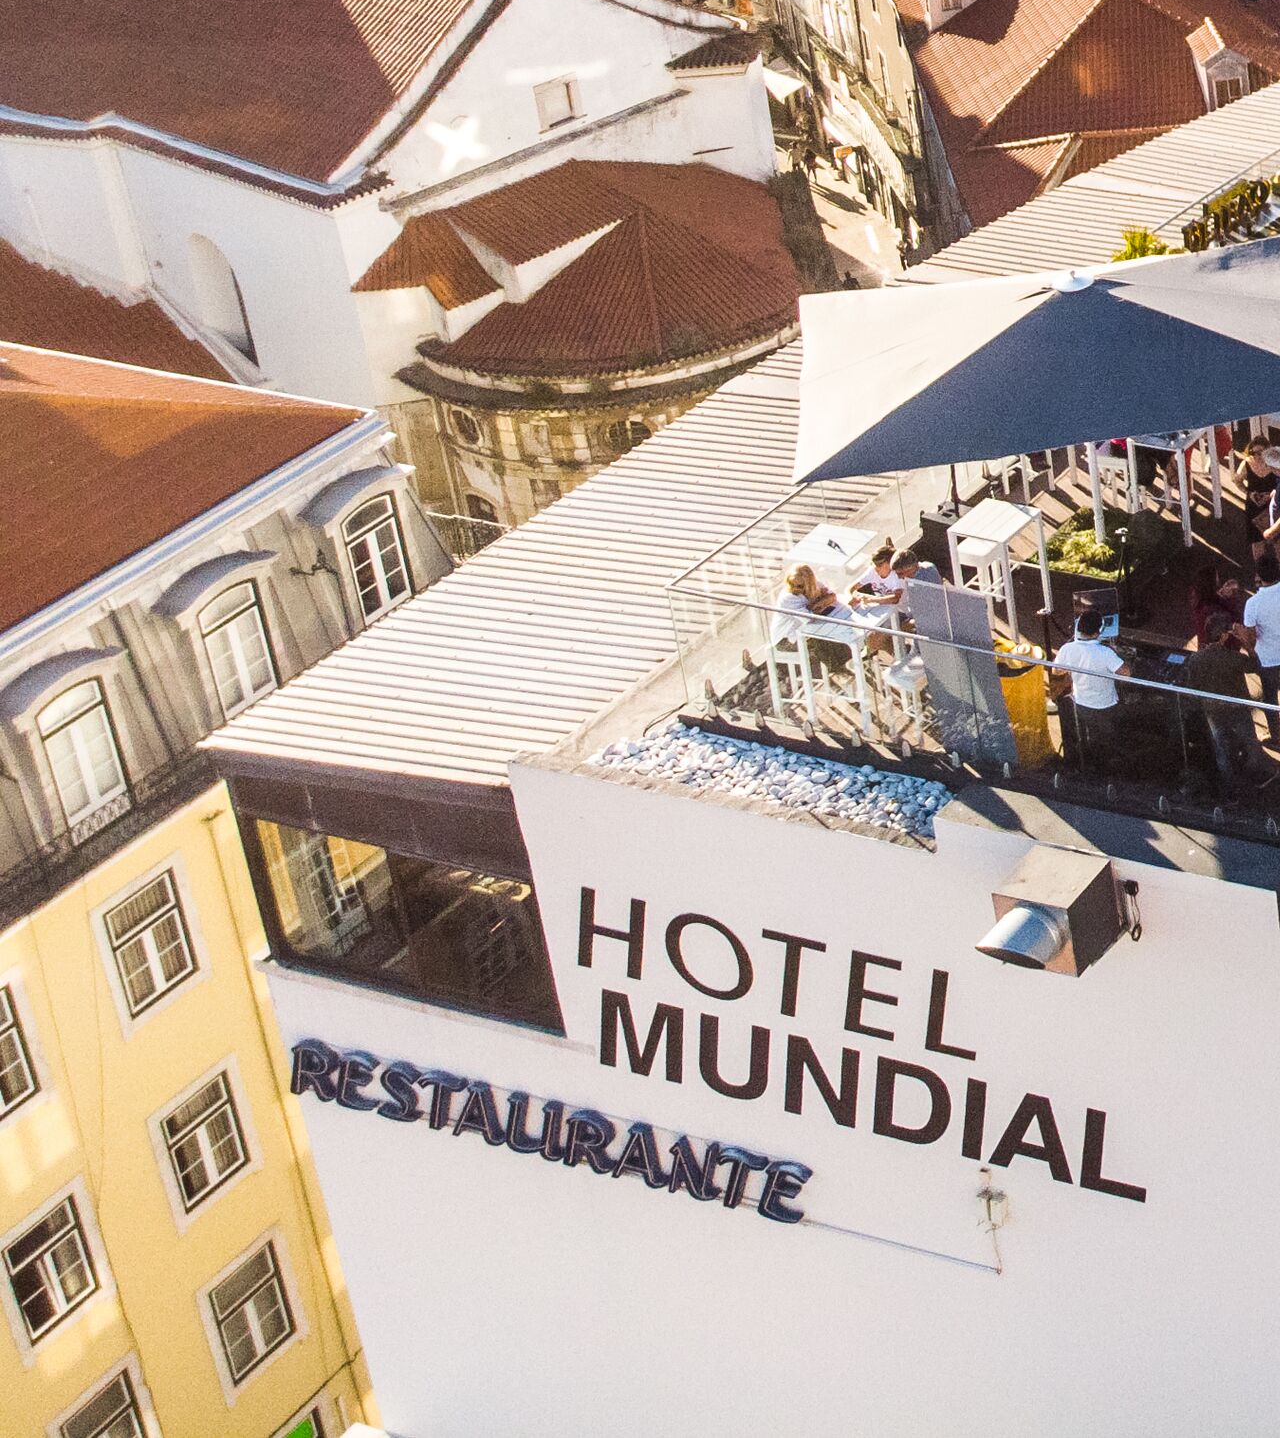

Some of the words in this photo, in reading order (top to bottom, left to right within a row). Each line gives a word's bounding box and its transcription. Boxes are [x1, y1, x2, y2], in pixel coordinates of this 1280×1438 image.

[577, 886, 977, 1061] HOTEL
[290, 1037, 815, 1225] RESTAURANTE
[599, 988, 1148, 1204] MUNDIAL
